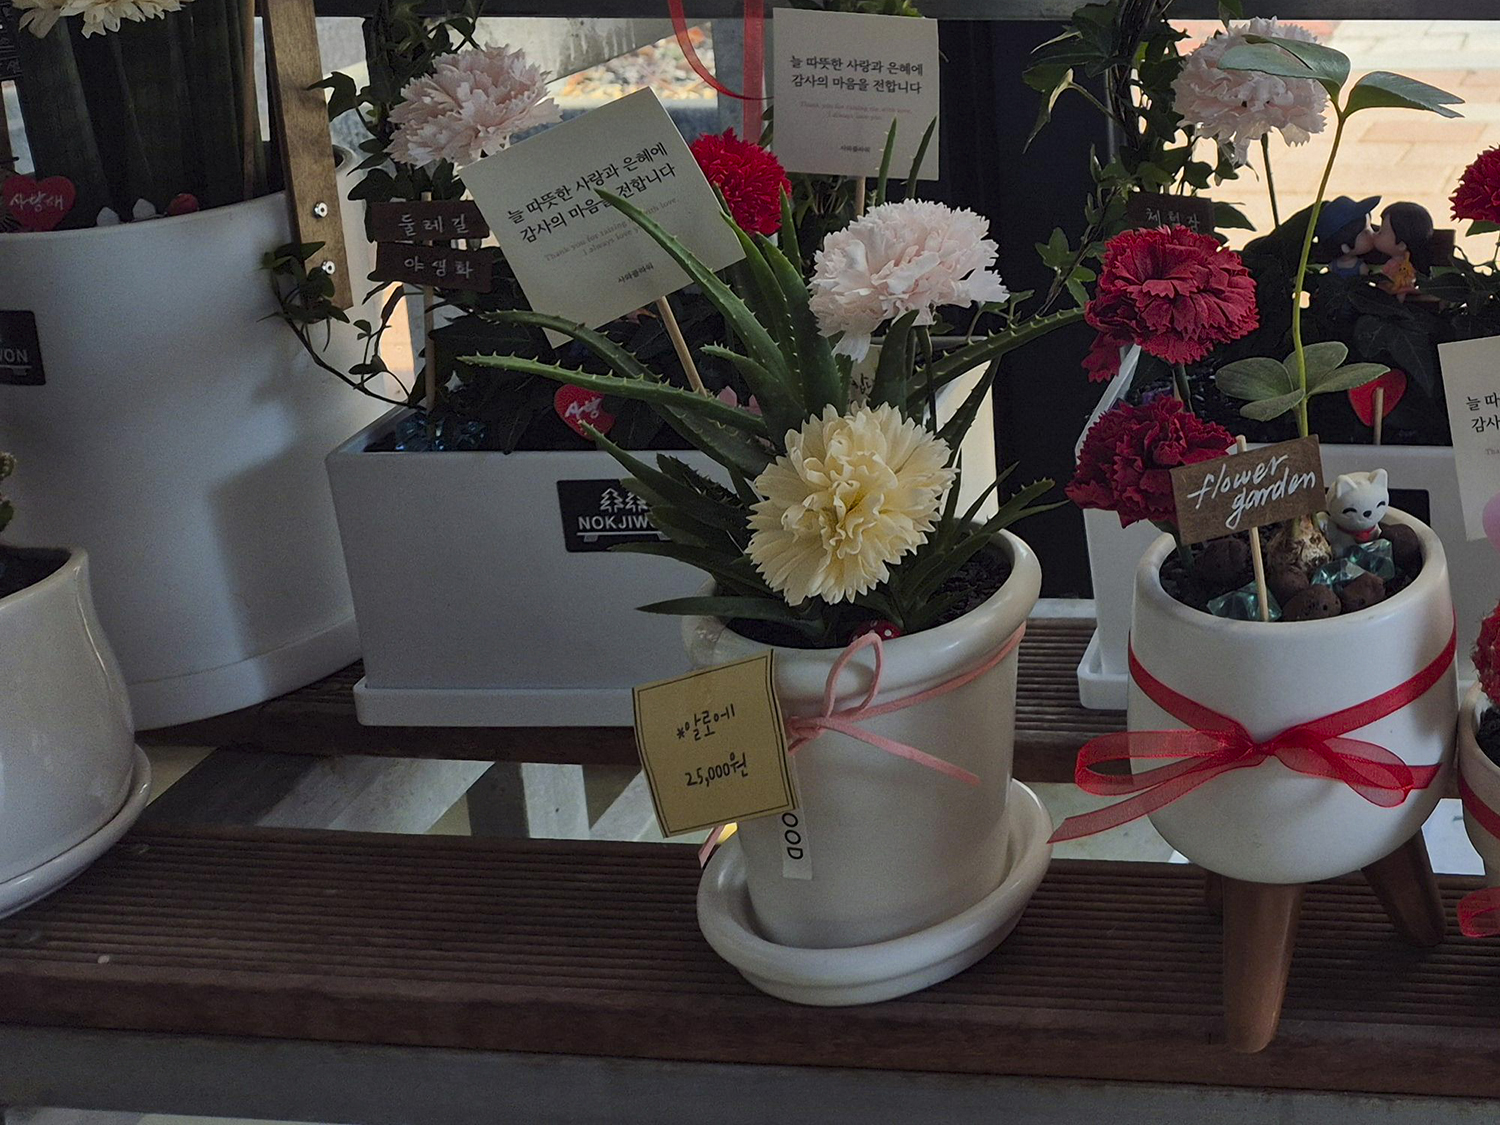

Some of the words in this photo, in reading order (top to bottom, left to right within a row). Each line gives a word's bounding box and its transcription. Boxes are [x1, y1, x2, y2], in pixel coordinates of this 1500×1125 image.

[790, 55, 803, 69] 늘
[806, 57, 843, 71] 따뜻한
[846, 59, 884, 74] 사랑과
[886, 61, 923, 75] 은혜에
[792, 75, 828, 89] 감사의
[832, 77, 869, 92] 마음을
[872, 80, 922, 94] 전합니다
[508, 207, 524, 225] 늘
[526, 185, 574, 215] 따뜻한
[575, 161, 621, 193] 사랑과
[622, 141, 669, 173] 은혜에
[520, 213, 568, 245] 감사의
[616, 163, 677, 199] 전합니다
[398, 213, 470, 239] 둘레길
[404, 255, 474, 279] 야생화
[1466, 396, 1480, 411] 늘
[1186, 455, 1290, 510] flower
[1225, 466, 1316, 531] garden
[684, 752, 749, 787] 25,000원
